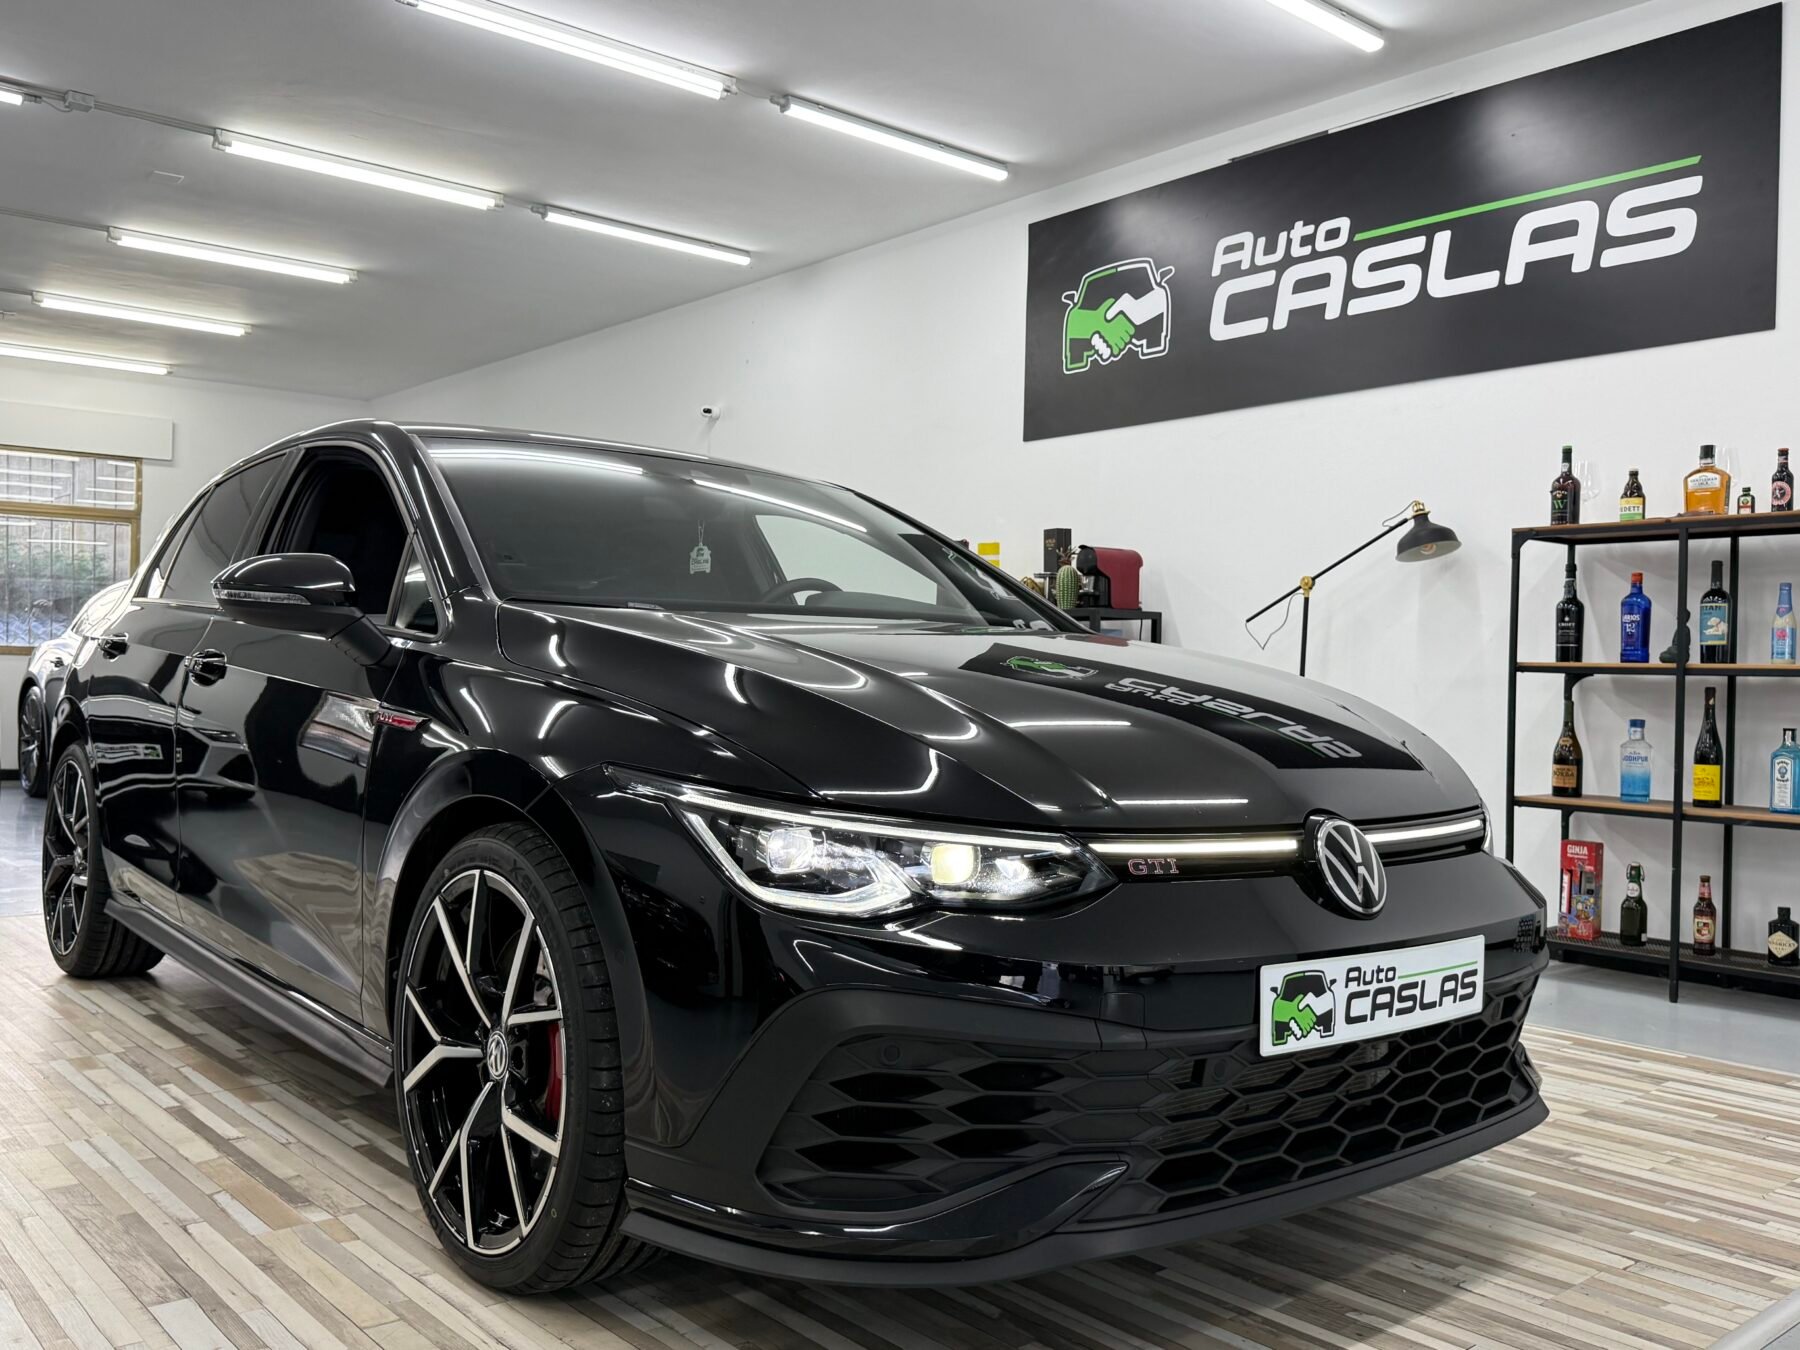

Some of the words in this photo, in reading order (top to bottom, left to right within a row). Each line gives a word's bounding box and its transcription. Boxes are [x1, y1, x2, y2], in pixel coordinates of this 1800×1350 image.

[1209, 174, 1704, 341] CASLAS
[1211, 216, 1351, 277] Auto
[1619, 505, 1641, 513] EDETT
[1127, 858, 1180, 875] GTI
[1344, 965, 1396, 989] Auto
[1344, 969, 1479, 1025] CASLAS
